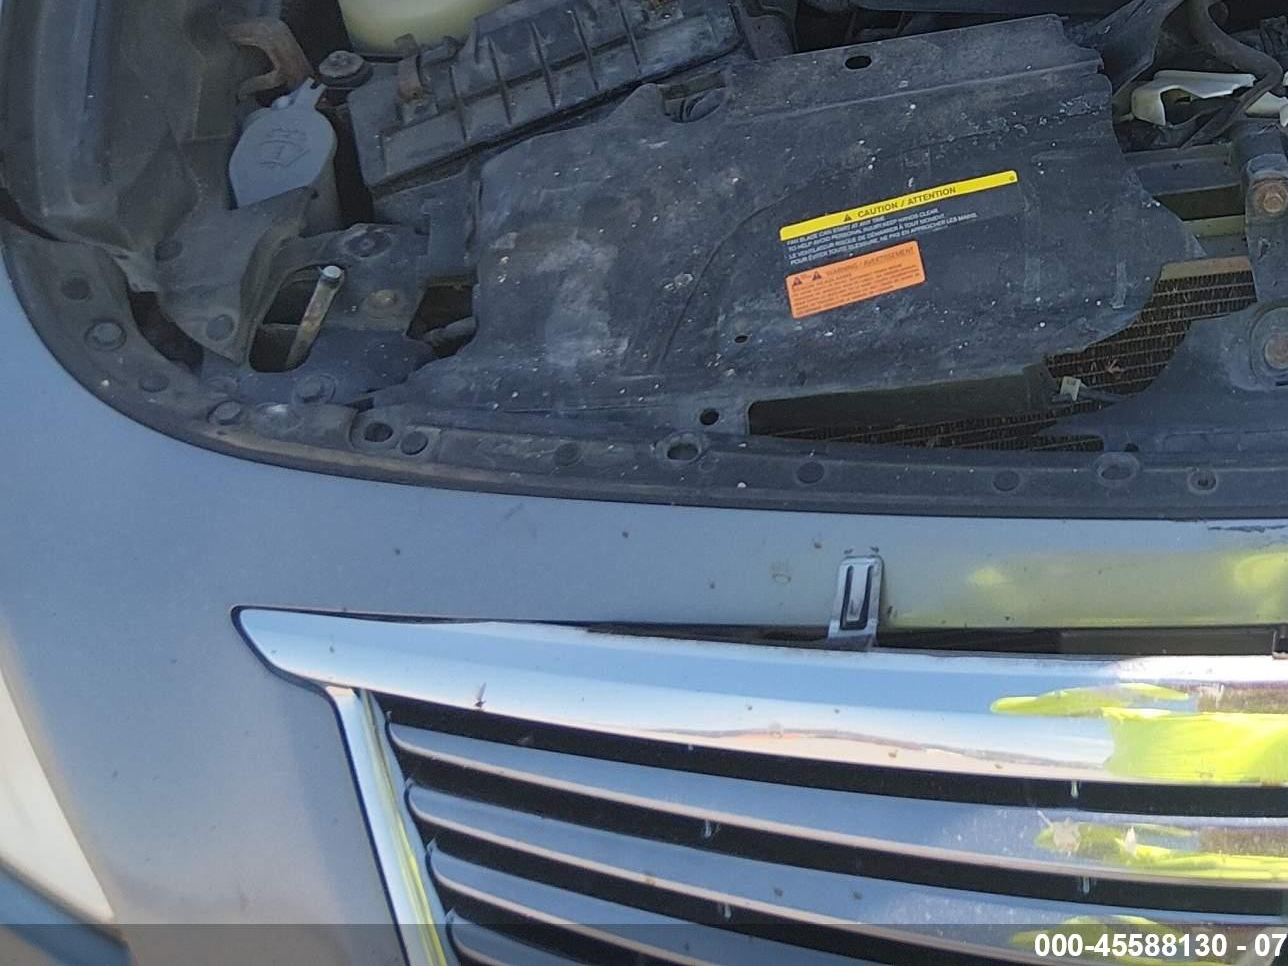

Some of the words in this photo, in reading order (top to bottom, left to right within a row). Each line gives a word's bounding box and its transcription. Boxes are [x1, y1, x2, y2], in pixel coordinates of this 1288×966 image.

[857, 201, 898, 217] CAUTION
[906, 186, 956, 205] ATTENTION
[797, 240, 812, 249] HELP
[897, 213, 918, 223] HANDS
[818, 229, 832, 237] CAN
[903, 220, 919, 228] TOUT
[790, 256, 808, 265] POUR
[945, 216, 957, 224] LES
[863, 246, 914, 266] AVERTISSEMENT
